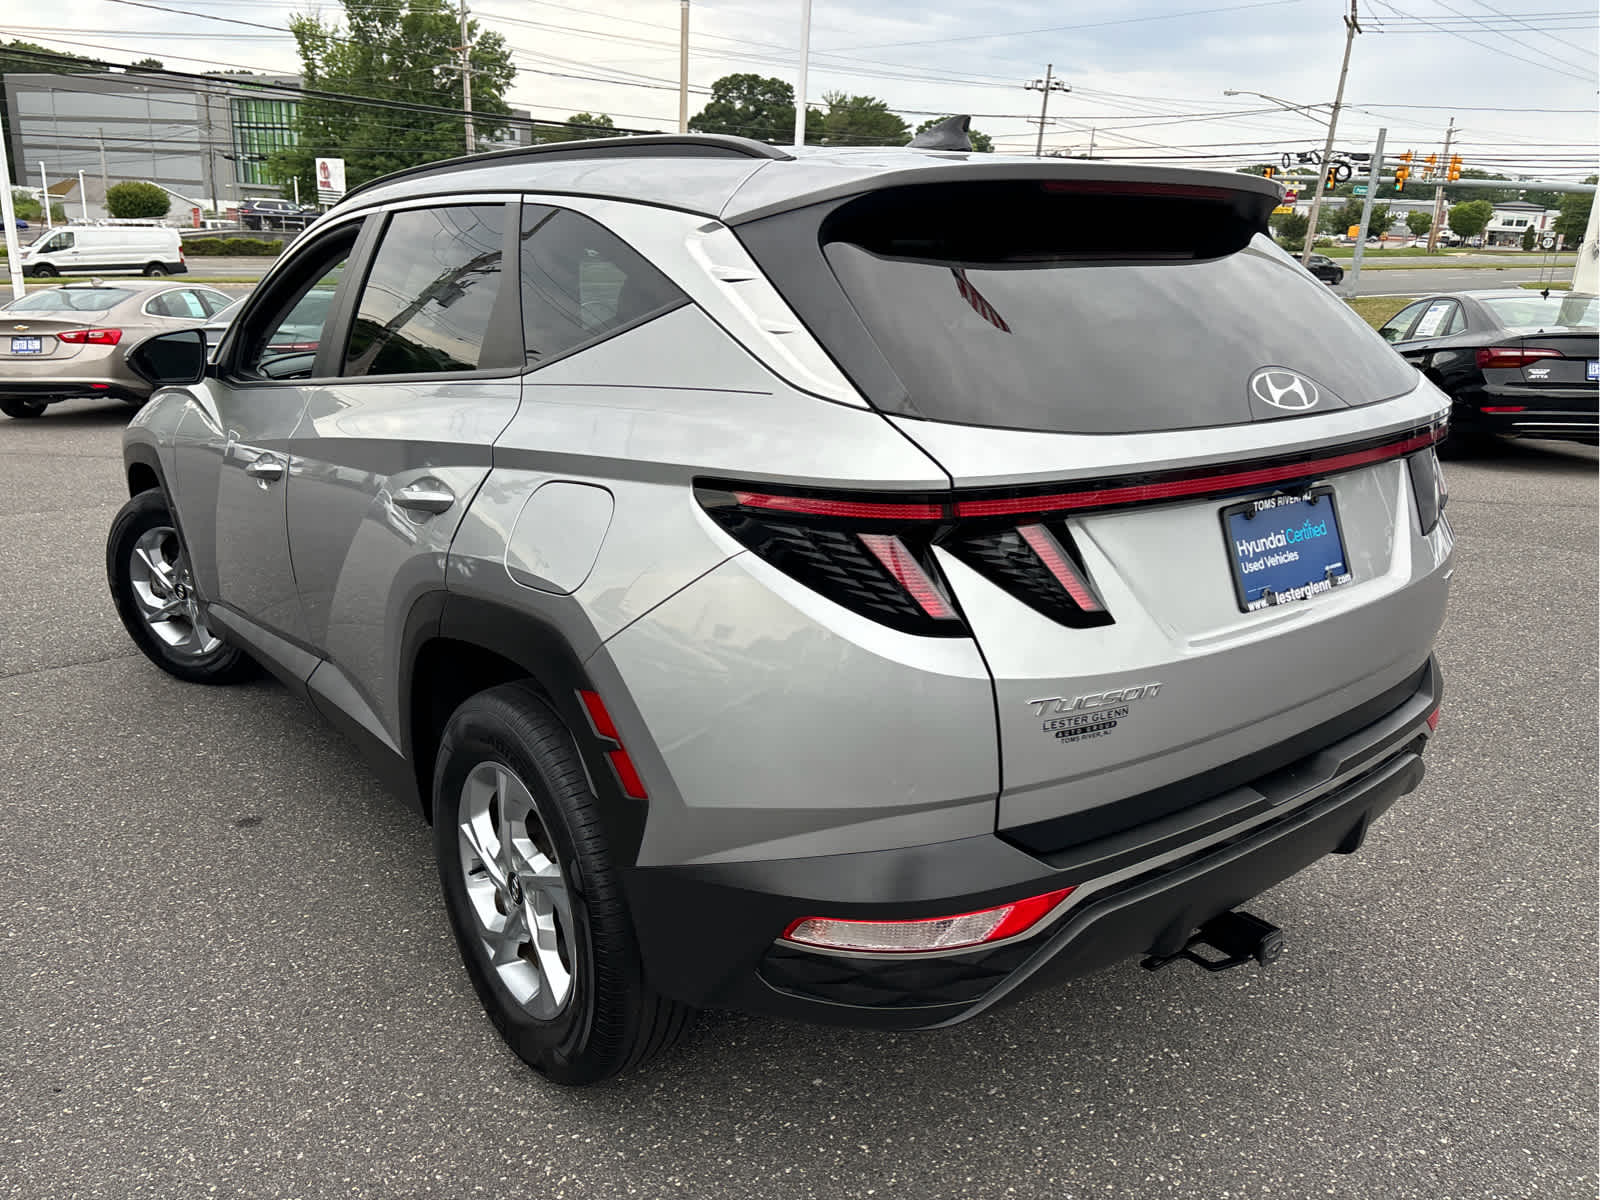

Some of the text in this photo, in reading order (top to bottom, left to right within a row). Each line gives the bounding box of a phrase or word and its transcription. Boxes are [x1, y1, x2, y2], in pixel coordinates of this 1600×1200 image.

[1253, 498, 1277, 512] TOMS
[1236, 519, 1328, 557] Hyundai Certified
[1241, 550, 1300, 574] Used Vehicles
[1043, 706, 1129, 731] LESTER GLENN
[1061, 735, 1080, 744] TOMS
